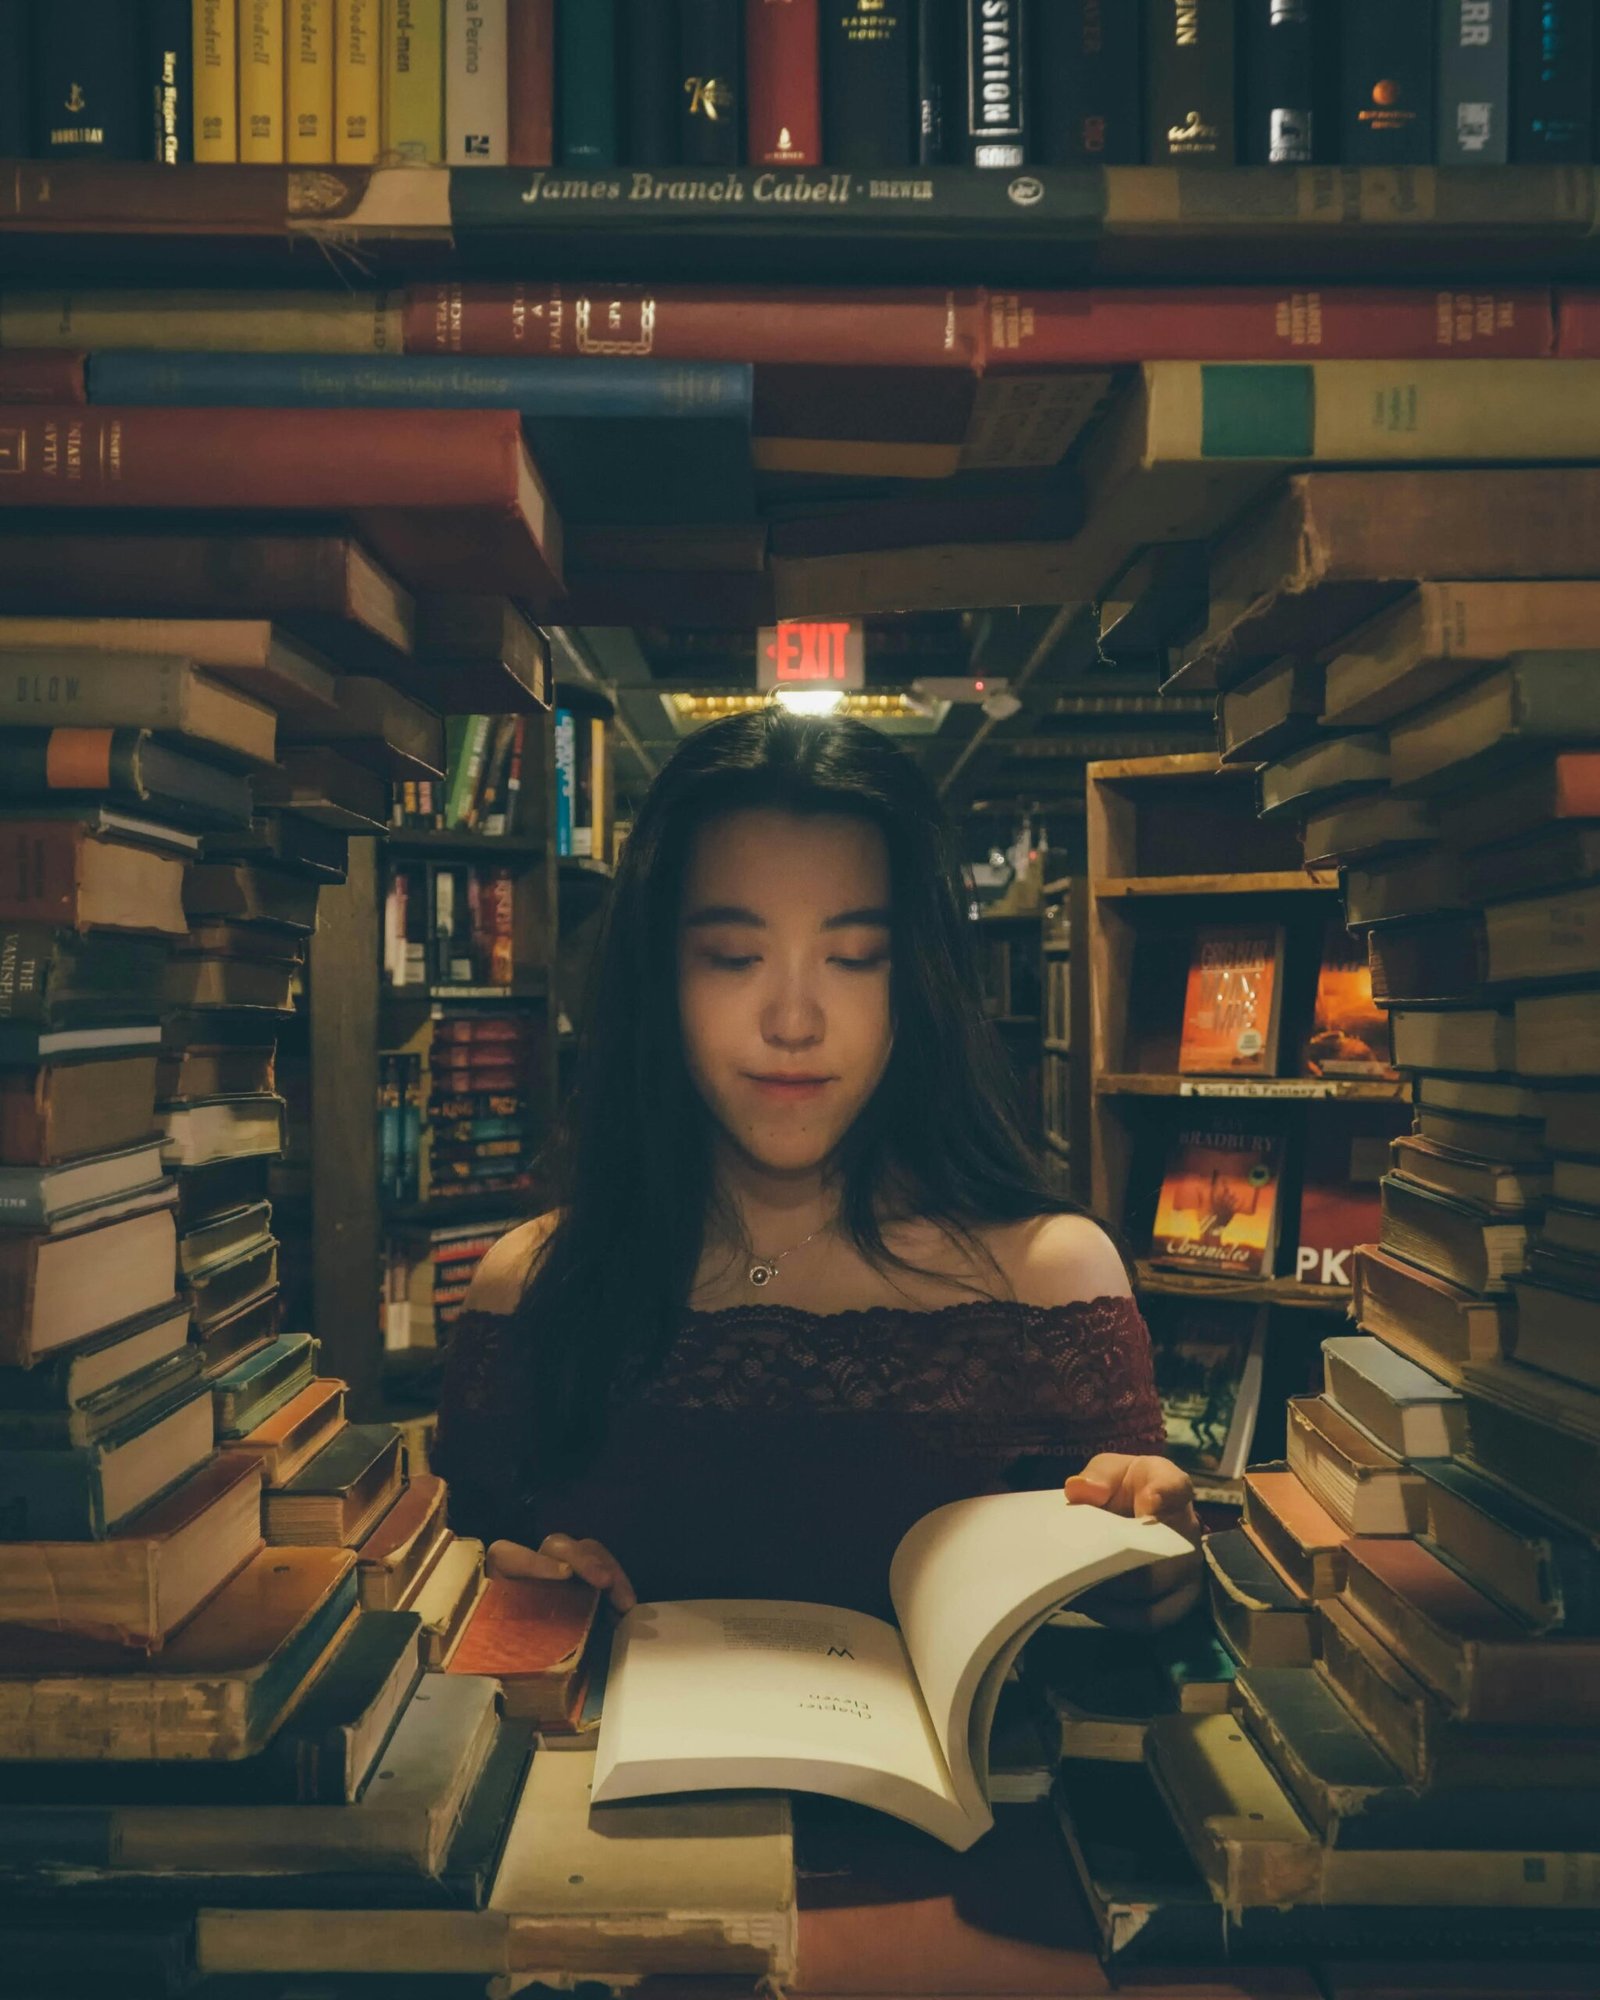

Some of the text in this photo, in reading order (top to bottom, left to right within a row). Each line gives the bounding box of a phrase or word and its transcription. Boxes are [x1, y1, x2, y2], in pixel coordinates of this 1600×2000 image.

[1460, 0, 1492, 47] RR
[466, 17, 483, 74] Perino
[521, 172, 934, 204] James Branch Cabell BREWER
[777, 623, 850, 680] EXIT
[1165, 1238, 1250, 1262] Chronicles
[800, 1703, 872, 1720] Chapter
[809, 1694, 870, 1710] Eleven
